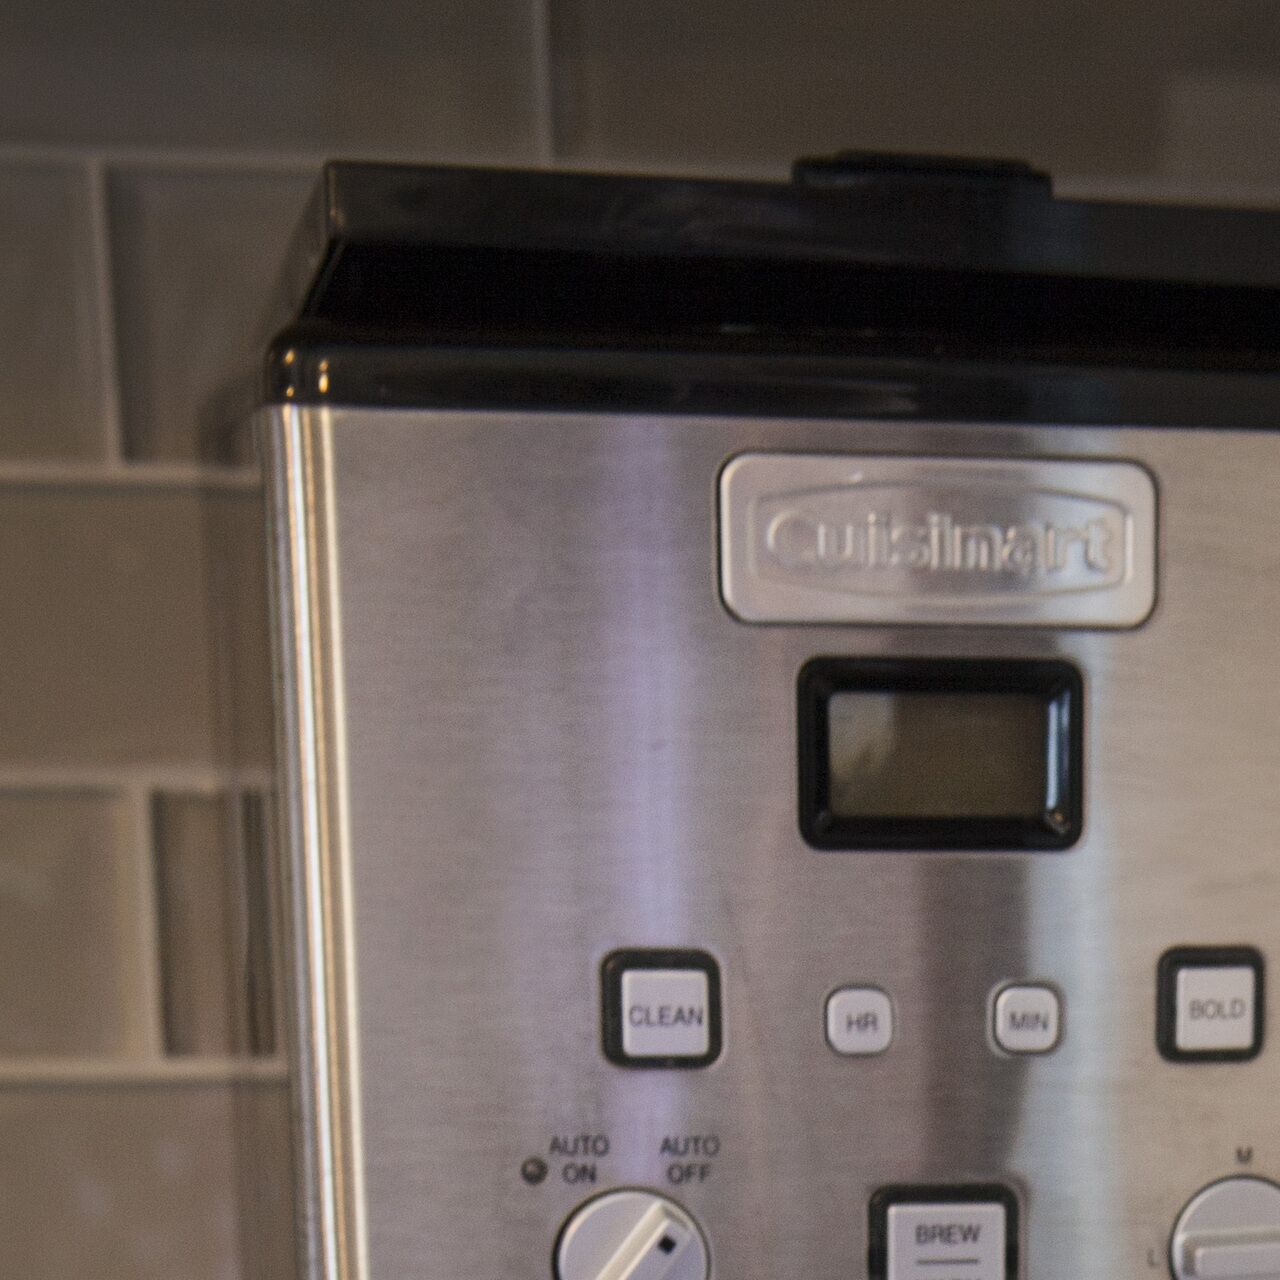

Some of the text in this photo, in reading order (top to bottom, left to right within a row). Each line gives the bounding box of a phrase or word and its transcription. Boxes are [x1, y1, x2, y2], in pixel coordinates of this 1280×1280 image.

[629, 1005, 703, 1026] CLEAN
[1189, 1000, 1245, 1020] BOLD
[846, 1013, 878, 1032] HR
[549, 1136, 609, 1157] AUTO
[660, 1136, 720, 1157] AUTO
[1236, 1147, 1252, 1164] M
[562, 1163, 597, 1184] ON
[667, 1163, 711, 1184] OFF
[915, 1224, 980, 1244] BREW
